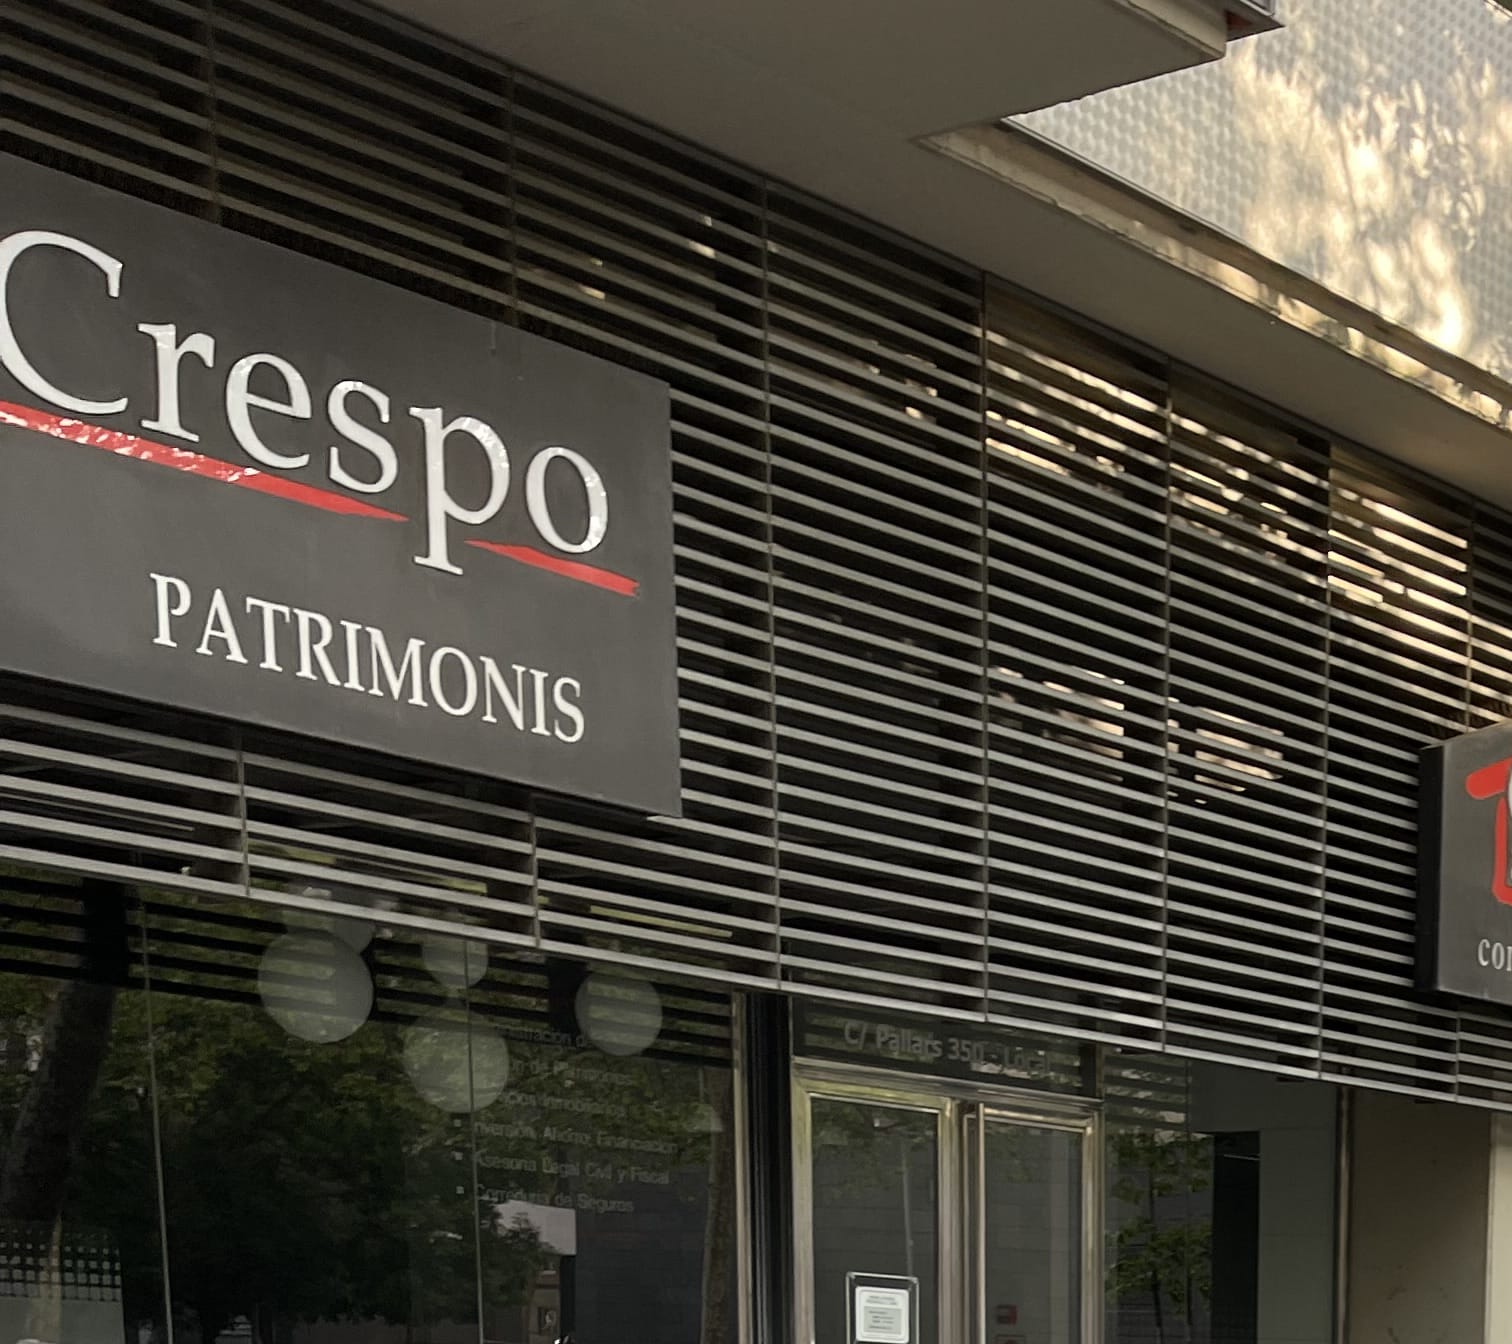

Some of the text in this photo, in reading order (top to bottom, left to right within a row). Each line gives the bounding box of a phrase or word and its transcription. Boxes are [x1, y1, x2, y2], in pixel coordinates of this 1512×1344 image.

[0, 229, 609, 576] Crespo
[149, 571, 587, 745] PATRIMONIS
[876, 1024, 944, 1058] Pallars
